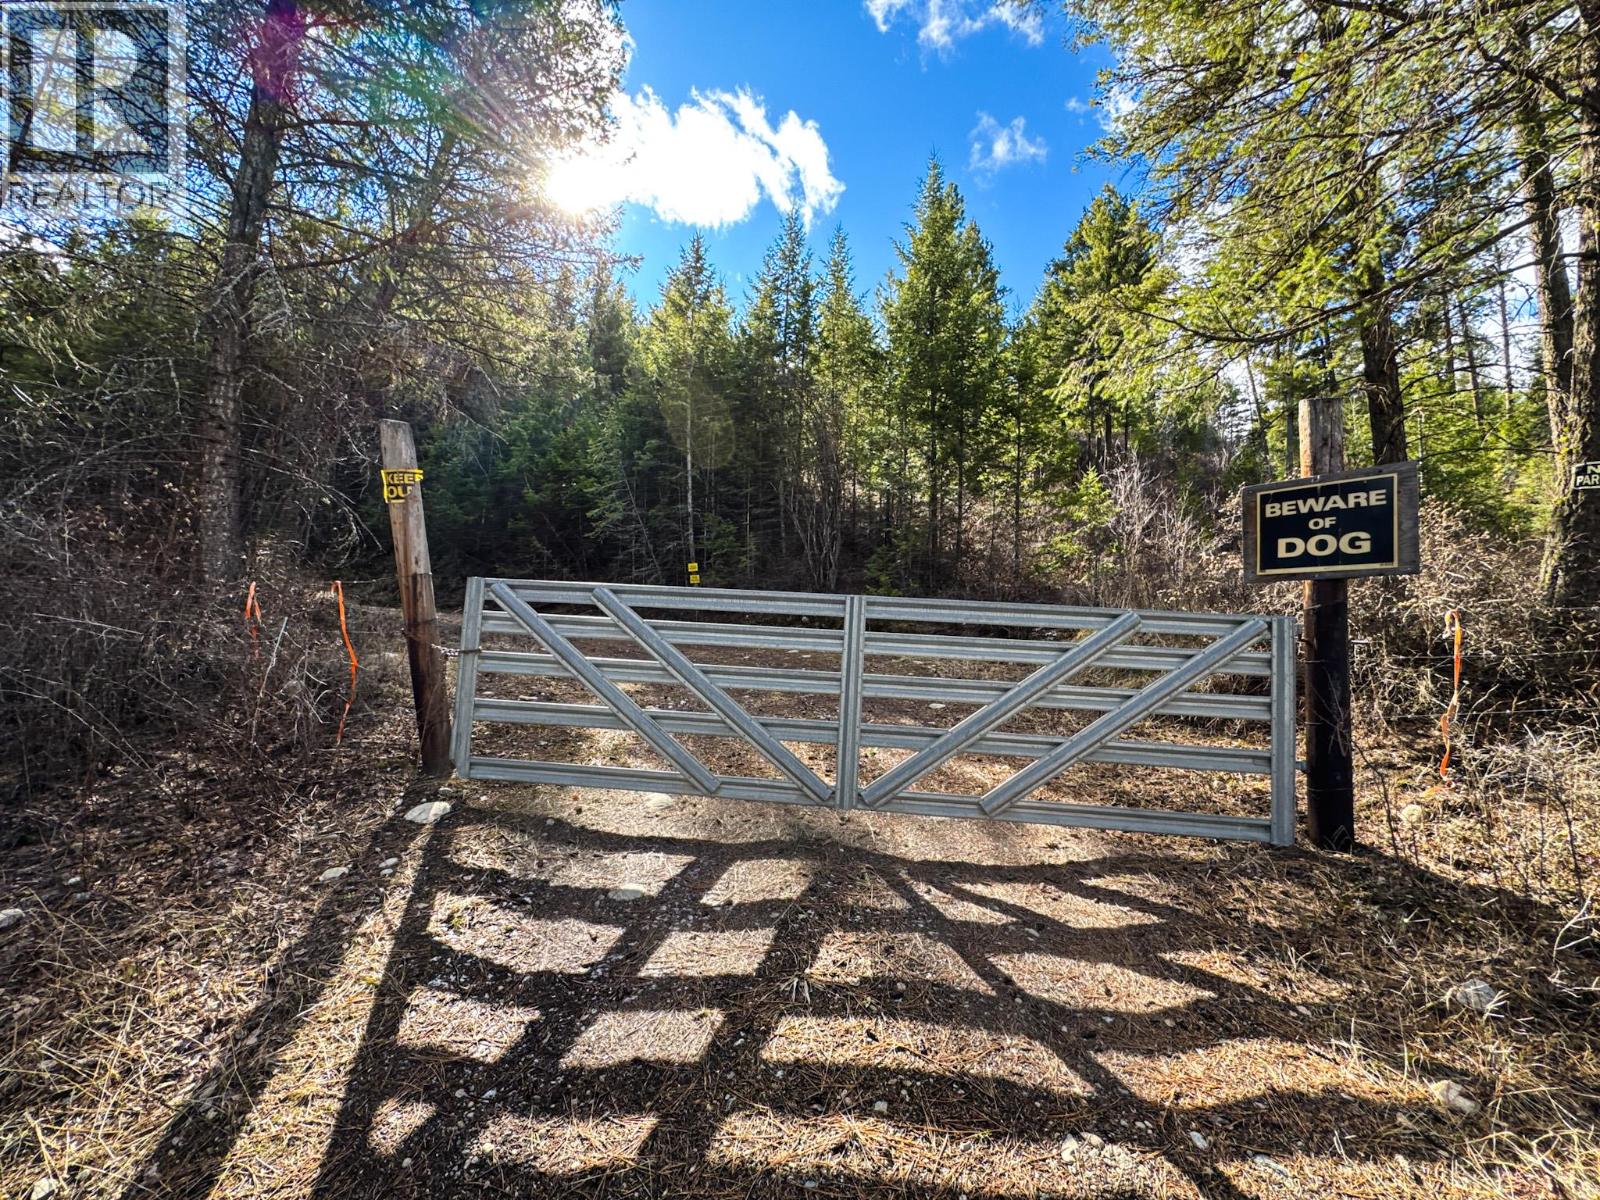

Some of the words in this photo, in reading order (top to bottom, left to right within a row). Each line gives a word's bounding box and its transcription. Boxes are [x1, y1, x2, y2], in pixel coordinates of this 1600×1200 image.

[1587, 465, 1600, 474] N
[1576, 474, 1600, 486] PAR
[387, 485, 412, 498] OU
[1265, 489, 1387, 518] BEWARE
[1308, 516, 1337, 530] OF
[1277, 531, 1372, 559] DOG
